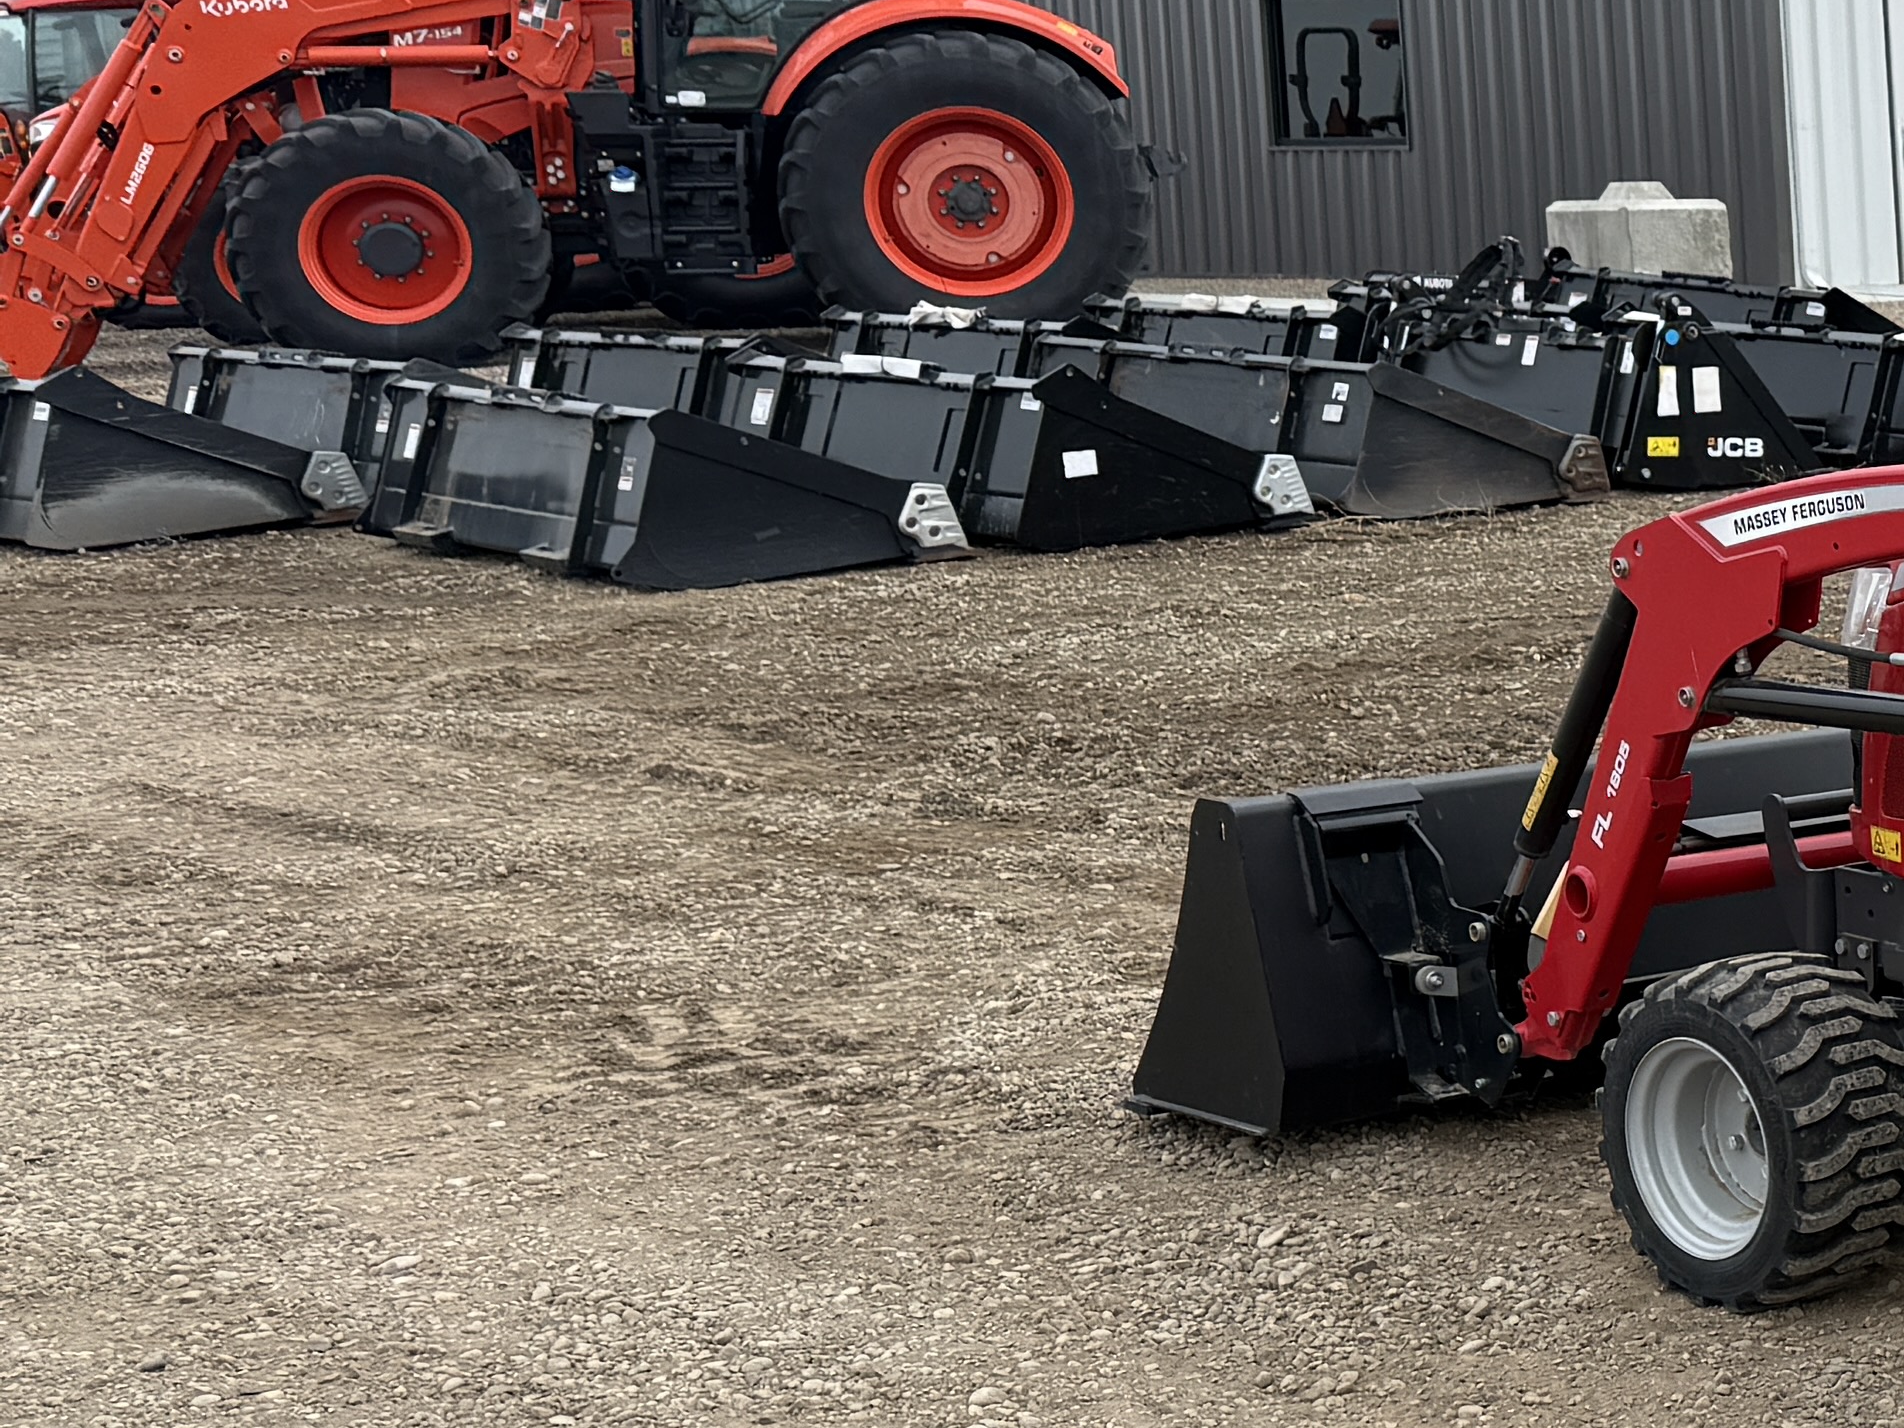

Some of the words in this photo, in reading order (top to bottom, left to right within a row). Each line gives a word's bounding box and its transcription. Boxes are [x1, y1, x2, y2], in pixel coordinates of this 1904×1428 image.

[1706, 437, 1764, 458] JCB
[1733, 507, 1787, 535] MASSEY
[1791, 493, 1866, 521] FERGUSON
